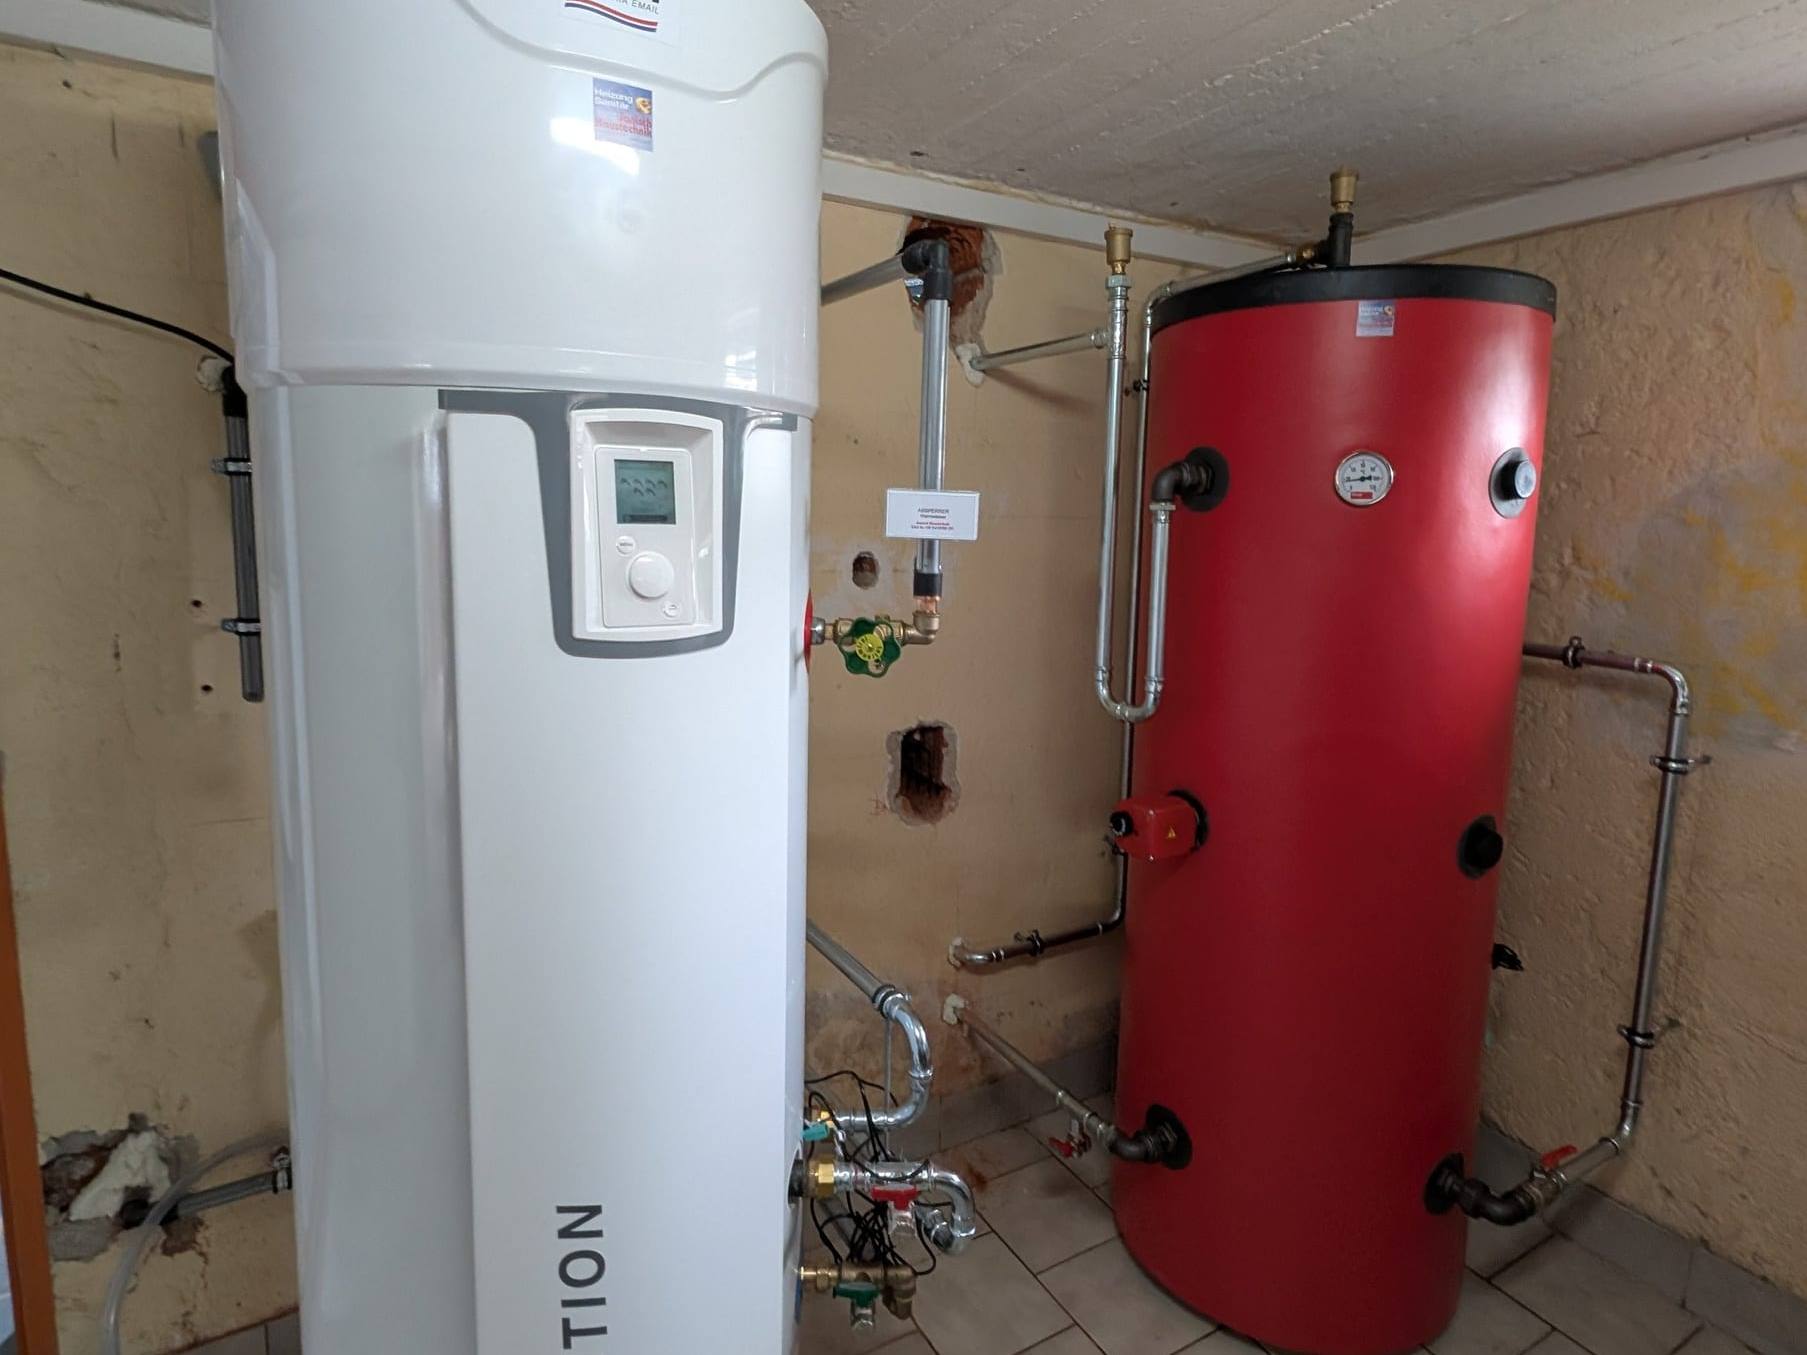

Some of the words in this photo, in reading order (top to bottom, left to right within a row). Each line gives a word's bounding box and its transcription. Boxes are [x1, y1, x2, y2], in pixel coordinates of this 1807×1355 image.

[632, 0, 660, 15] EMAIL
[594, 87, 633, 104] Heizung
[556, 1204, 608, 1350] TION
